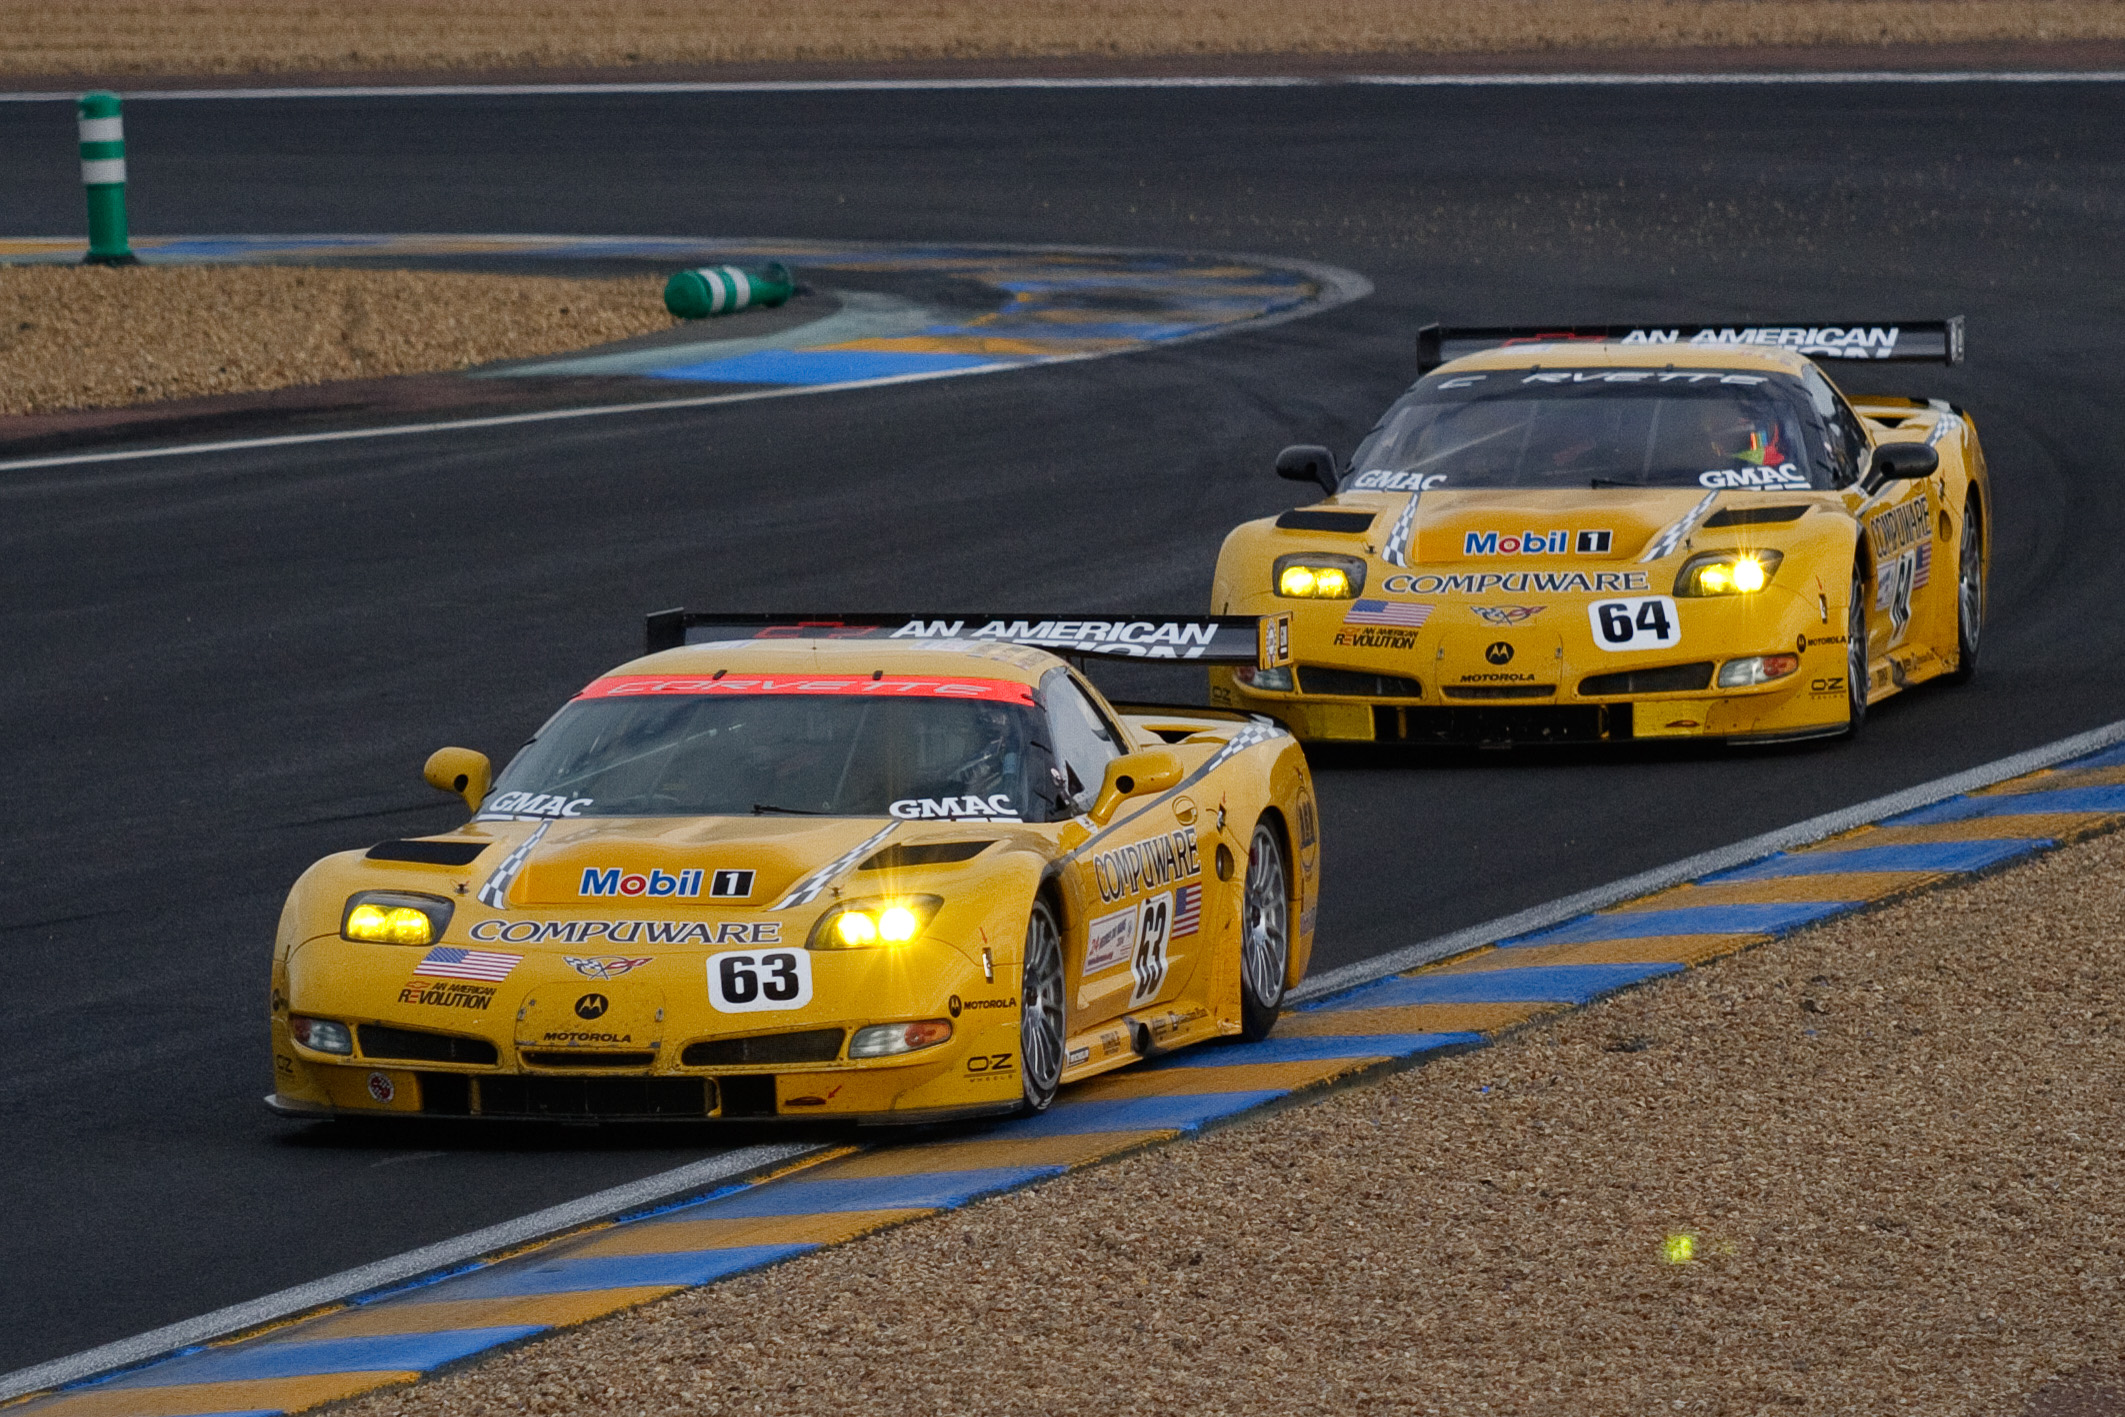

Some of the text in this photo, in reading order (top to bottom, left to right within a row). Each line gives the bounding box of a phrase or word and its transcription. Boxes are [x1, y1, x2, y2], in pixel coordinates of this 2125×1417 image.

[1621, 327, 1899, 347] AN AMERICAN
[1354, 469, 1448, 491] GMAC
[1699, 462, 1806, 489] GMAC
[1871, 496, 1932, 559] COMPUWARE
[1465, 531, 1569, 554] Mobil
[1383, 572, 1649, 594] COMPUWARE
[889, 620, 1219, 645] AN AMERICAN
[1598, 600, 1671, 643] 64
[1333, 633, 1416, 649] REVOLUTION
[1377, 628, 1419, 638] AMERICAN
[1807, 635, 1847, 646] MOTOROLA
[607, 680, 992, 697] CORVETTE
[1459, 673, 1536, 683] MOTOROLA
[489, 791, 595, 817] GMAC
[889, 793, 1018, 819] GMAC
[1093, 827, 1202, 903] COMPUWARE
[579, 868, 702, 896] Mobil
[469, 919, 782, 943] COMPUWARE
[1136, 901, 1167, 1000] 63
[432, 982, 498, 996] AN AMERICAN
[719, 953, 800, 1004] 63
[398, 988, 493, 1010] REVOLUTION
[963, 997, 1017, 1010] MOTOROLA
[543, 1031, 632, 1043] MOTOROLA
